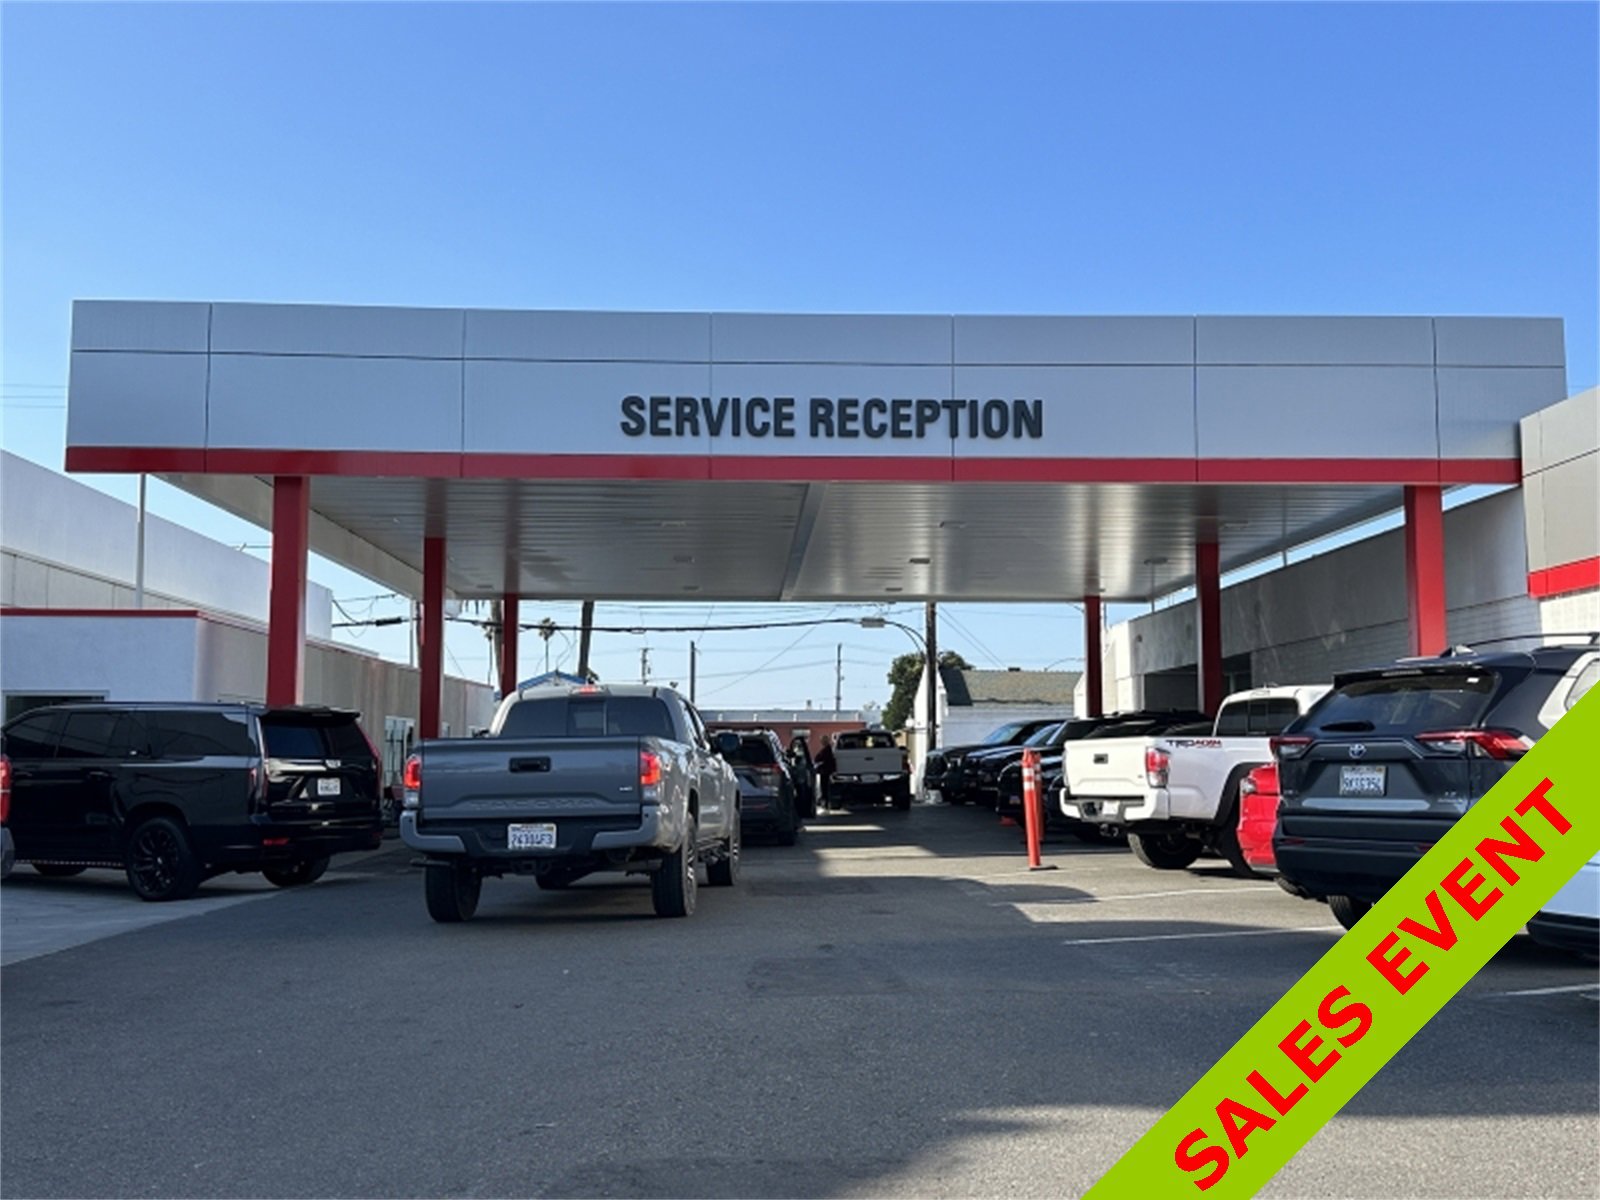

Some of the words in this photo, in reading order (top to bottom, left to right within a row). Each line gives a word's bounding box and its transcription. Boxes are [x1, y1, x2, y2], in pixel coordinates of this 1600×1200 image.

[620, 395, 796, 438] SERVICE
[809, 397, 1044, 440] RECEPTION
[471, 798, 594, 810] TACOMA
